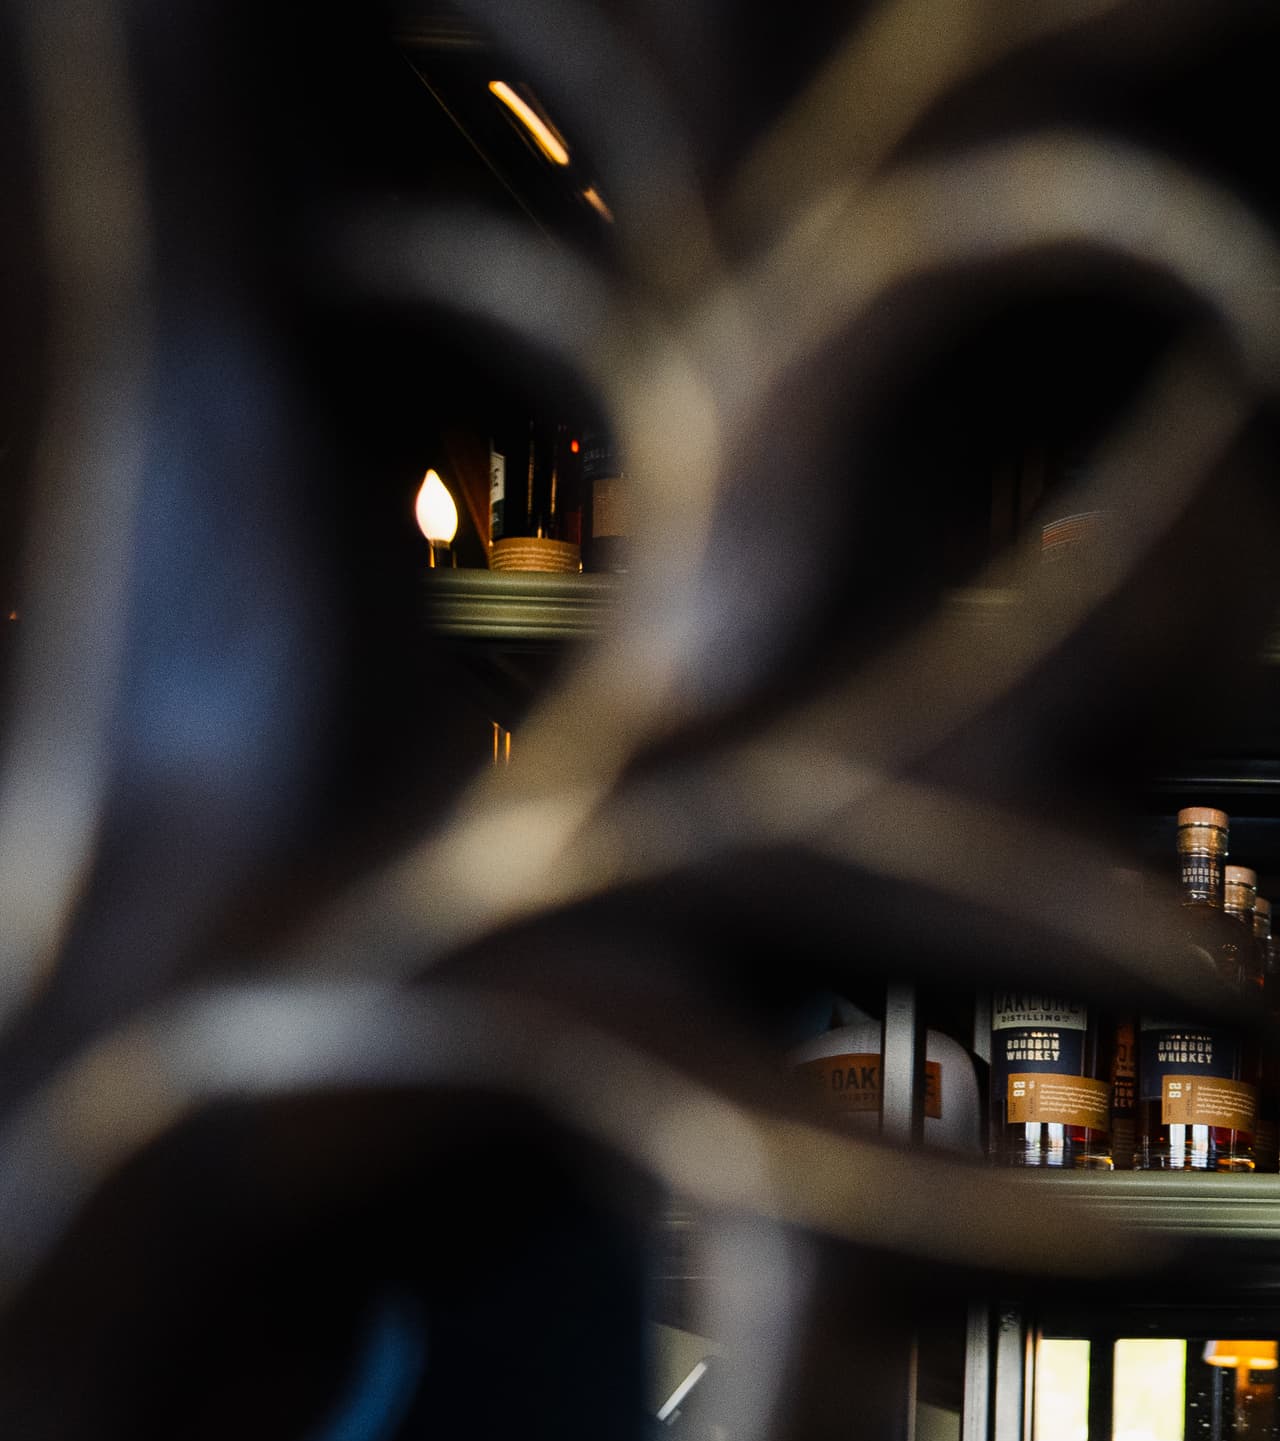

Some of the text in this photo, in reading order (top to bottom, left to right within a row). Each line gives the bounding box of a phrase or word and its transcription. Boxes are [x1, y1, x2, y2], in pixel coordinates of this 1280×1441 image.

[1007, 1039, 1059, 1049] BOURBON
[1159, 1041, 1212, 1052] BOURBON
[1007, 1051, 1059, 1061] WHISKEY
[1158, 1052, 1212, 1064] WHISKEY
